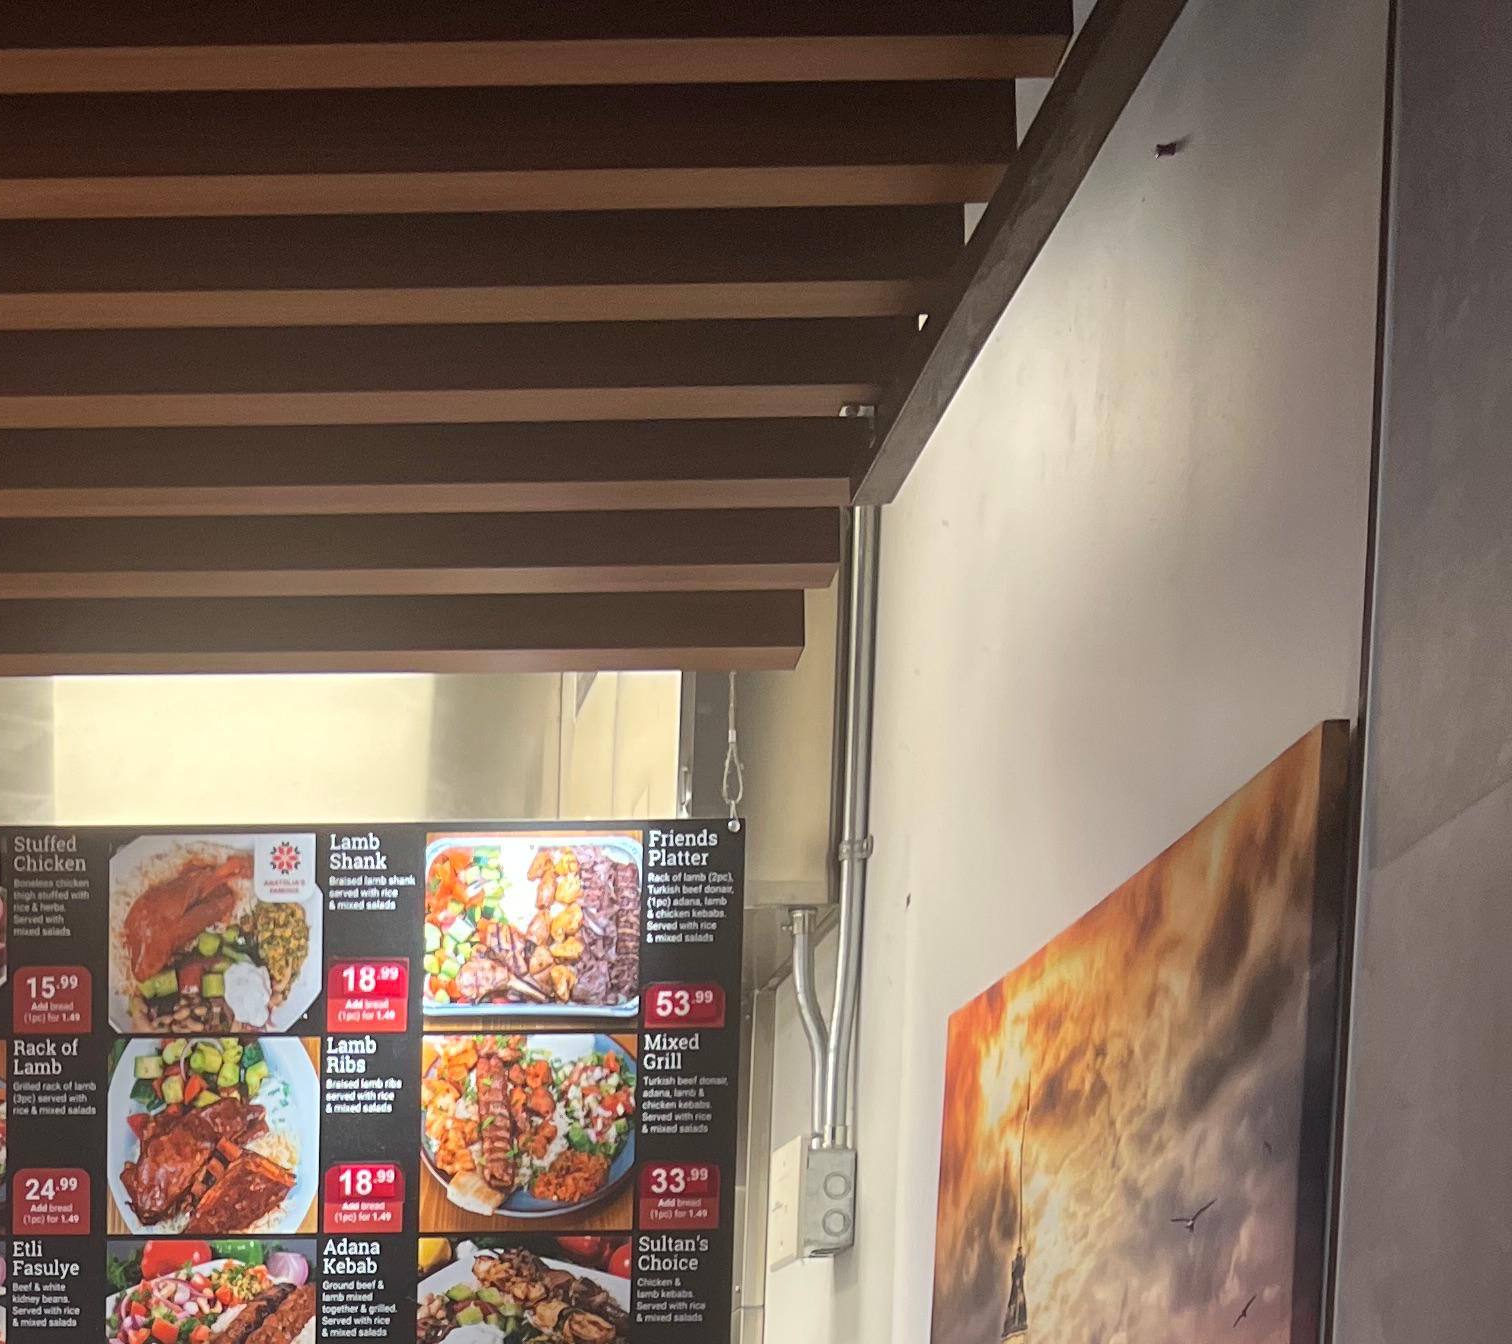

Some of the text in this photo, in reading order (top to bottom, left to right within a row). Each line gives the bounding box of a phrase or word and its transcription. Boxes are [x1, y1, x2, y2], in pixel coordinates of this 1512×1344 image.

[15, 834, 77, 852] Stuffed
[330, 833, 380, 853] Lamb
[648, 830, 717, 847] Friends
[14, 854, 86, 872] Chicken
[330, 851, 387, 870] Shank
[648, 849, 708, 867] Platter
[27, 975, 78, 998] 15.99
[343, 966, 398, 992] 18.99
[656, 991, 713, 1017] 53.99
[14, 1038, 78, 1056] Rack of
[327, 1035, 376, 1056] Lamb
[644, 1034, 699, 1050] Mixed
[14, 1058, 61, 1075] Lamb
[326, 1055, 365, 1073] Ribs
[643, 1052, 681, 1070] Grill
[26, 1177, 77, 1200] 24.99
[339, 1169, 395, 1195] 18.99
[651, 1168, 708, 1193] 33.99
[13, 1240, 42, 1257] Etli
[323, 1238, 380, 1255] Adana
[639, 1235, 708, 1255] Sultan's
[13, 1259, 79, 1279] Fasulye
[323, 1257, 377, 1274] Kebab
[638, 1254, 698, 1271] Choice
